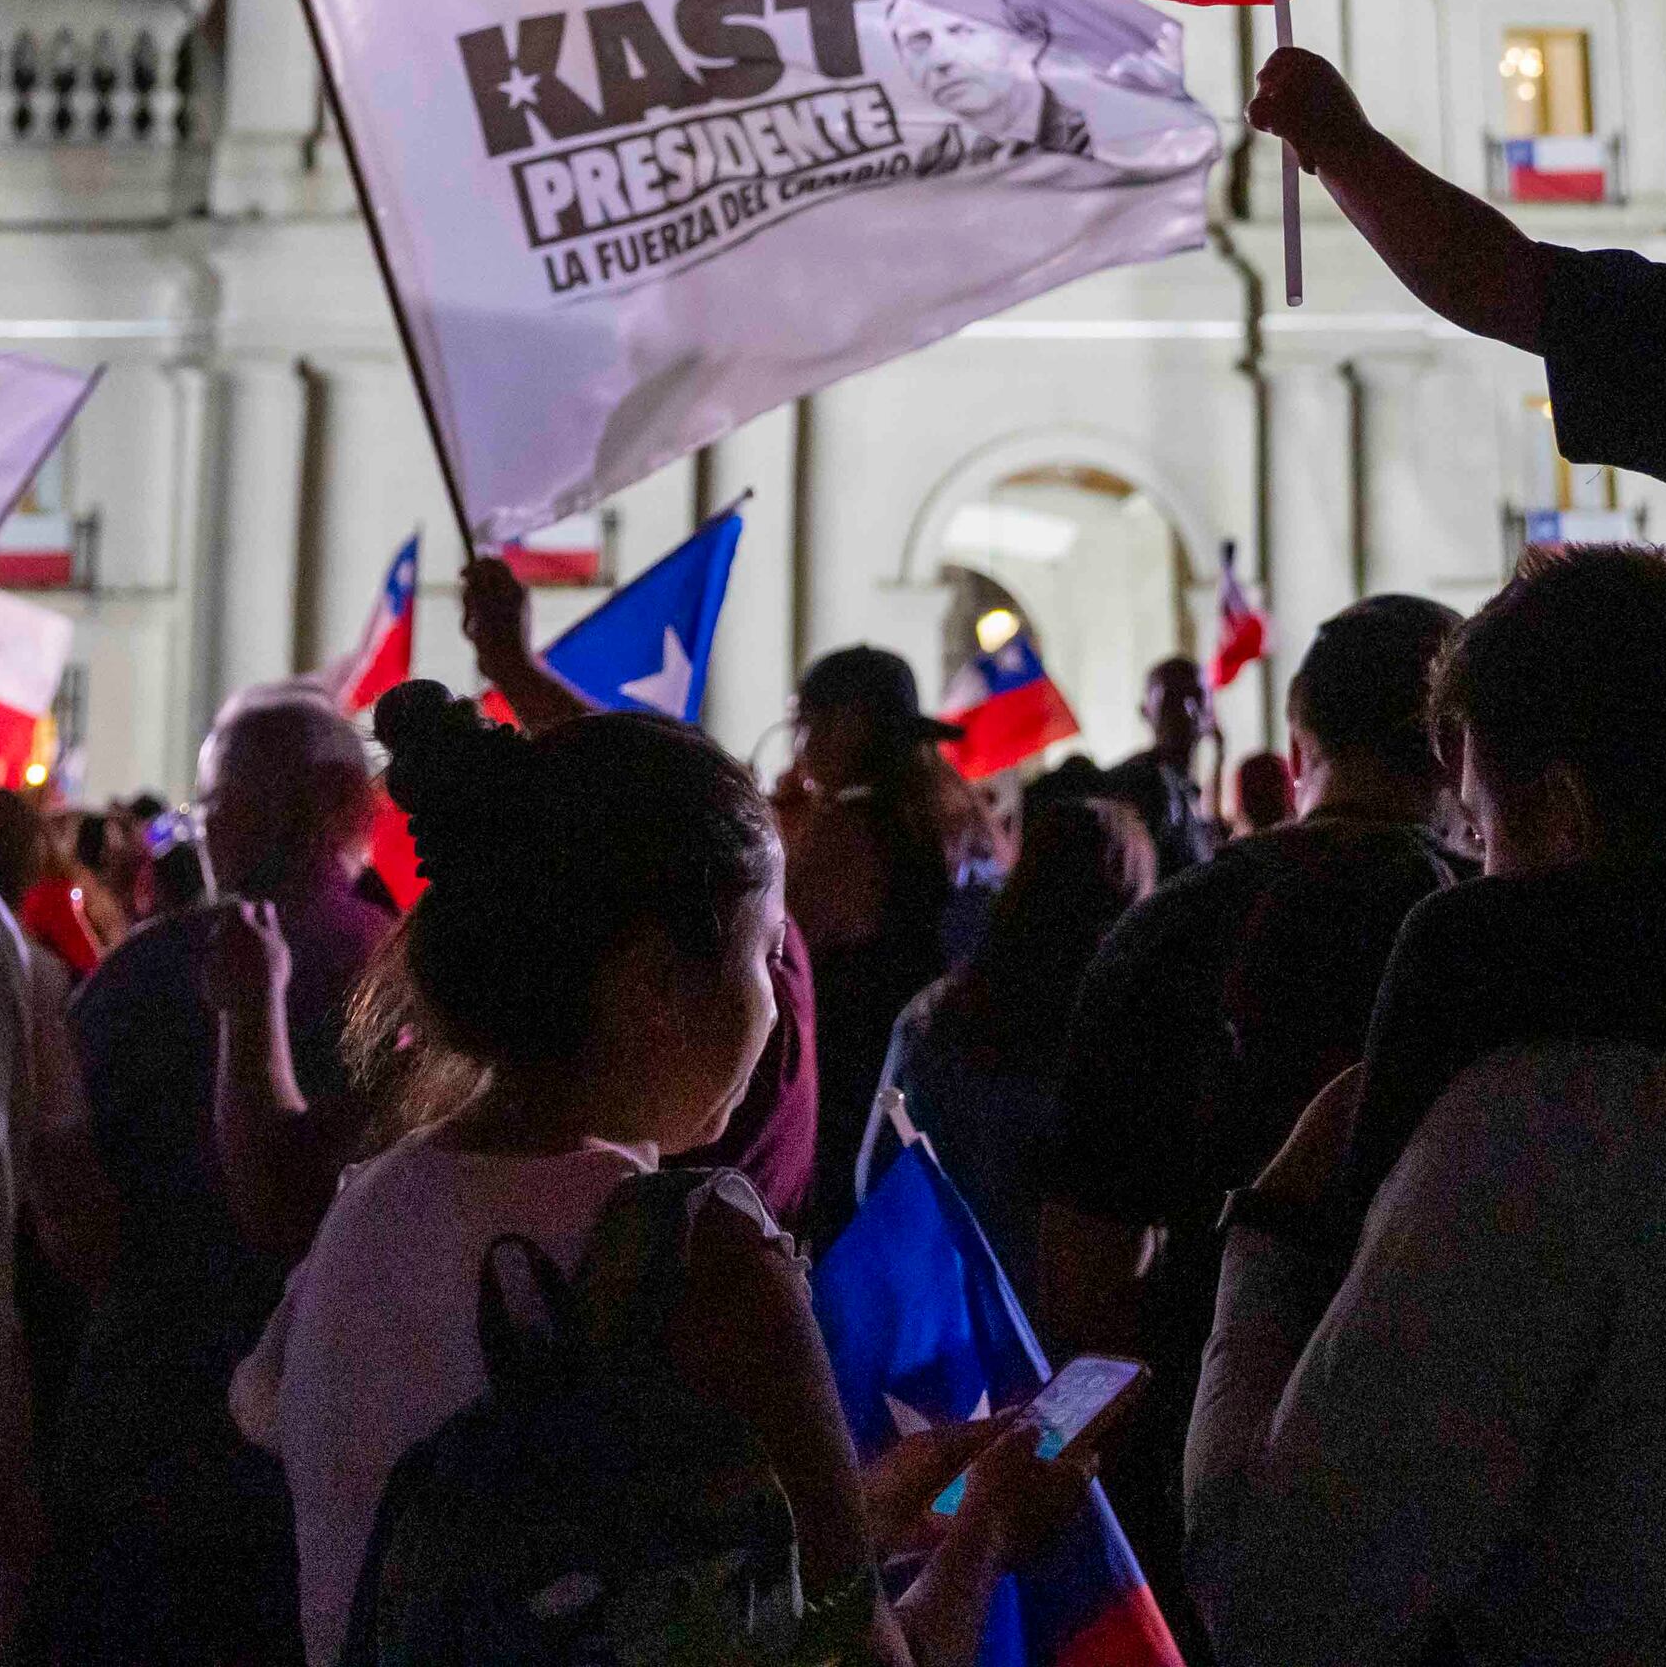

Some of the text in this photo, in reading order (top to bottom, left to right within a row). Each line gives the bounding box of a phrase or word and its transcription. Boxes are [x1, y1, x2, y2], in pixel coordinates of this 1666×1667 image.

[520, 84, 899, 242] PRESIDENTE
[541, 250, 589, 294] LA
[596, 214, 717, 281] FUERZA
